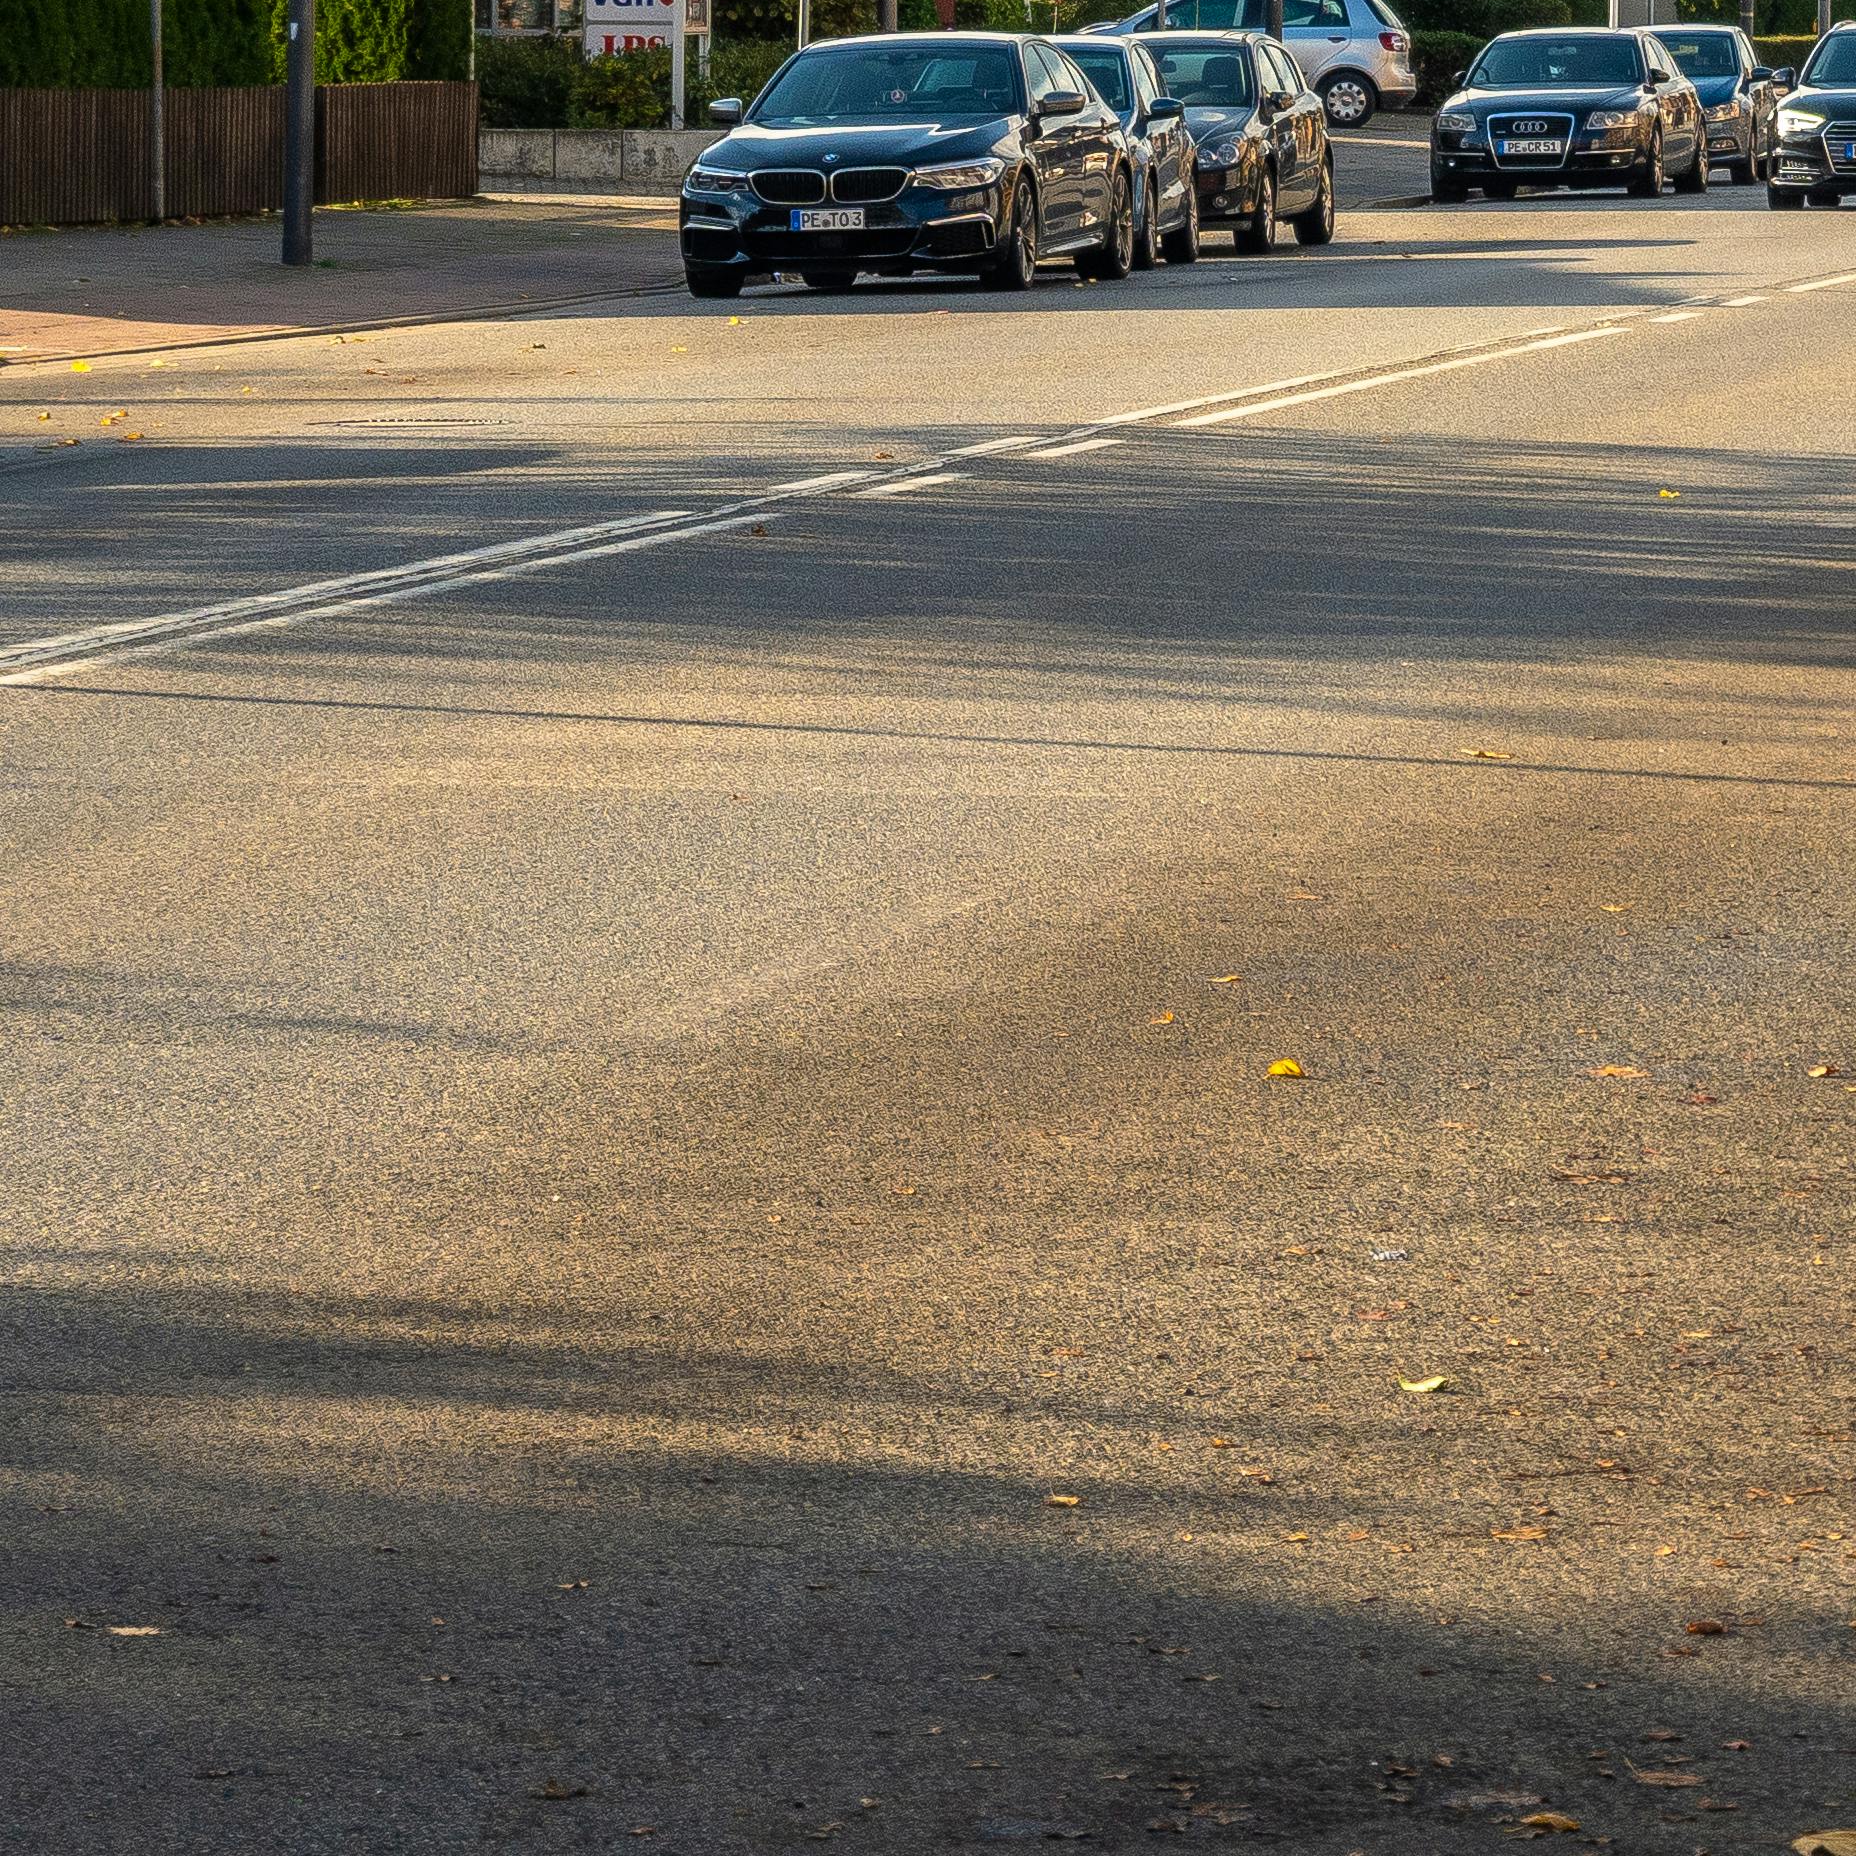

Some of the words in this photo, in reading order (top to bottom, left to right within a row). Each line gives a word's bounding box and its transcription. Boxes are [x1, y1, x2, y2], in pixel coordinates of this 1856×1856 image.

[1508, 142, 1521, 152] PE
[1528, 141, 1542, 152] CR
[1543, 141, 1557, 152] 51
[802, 212, 821, 228] PE
[852, 212, 862, 227] 3
